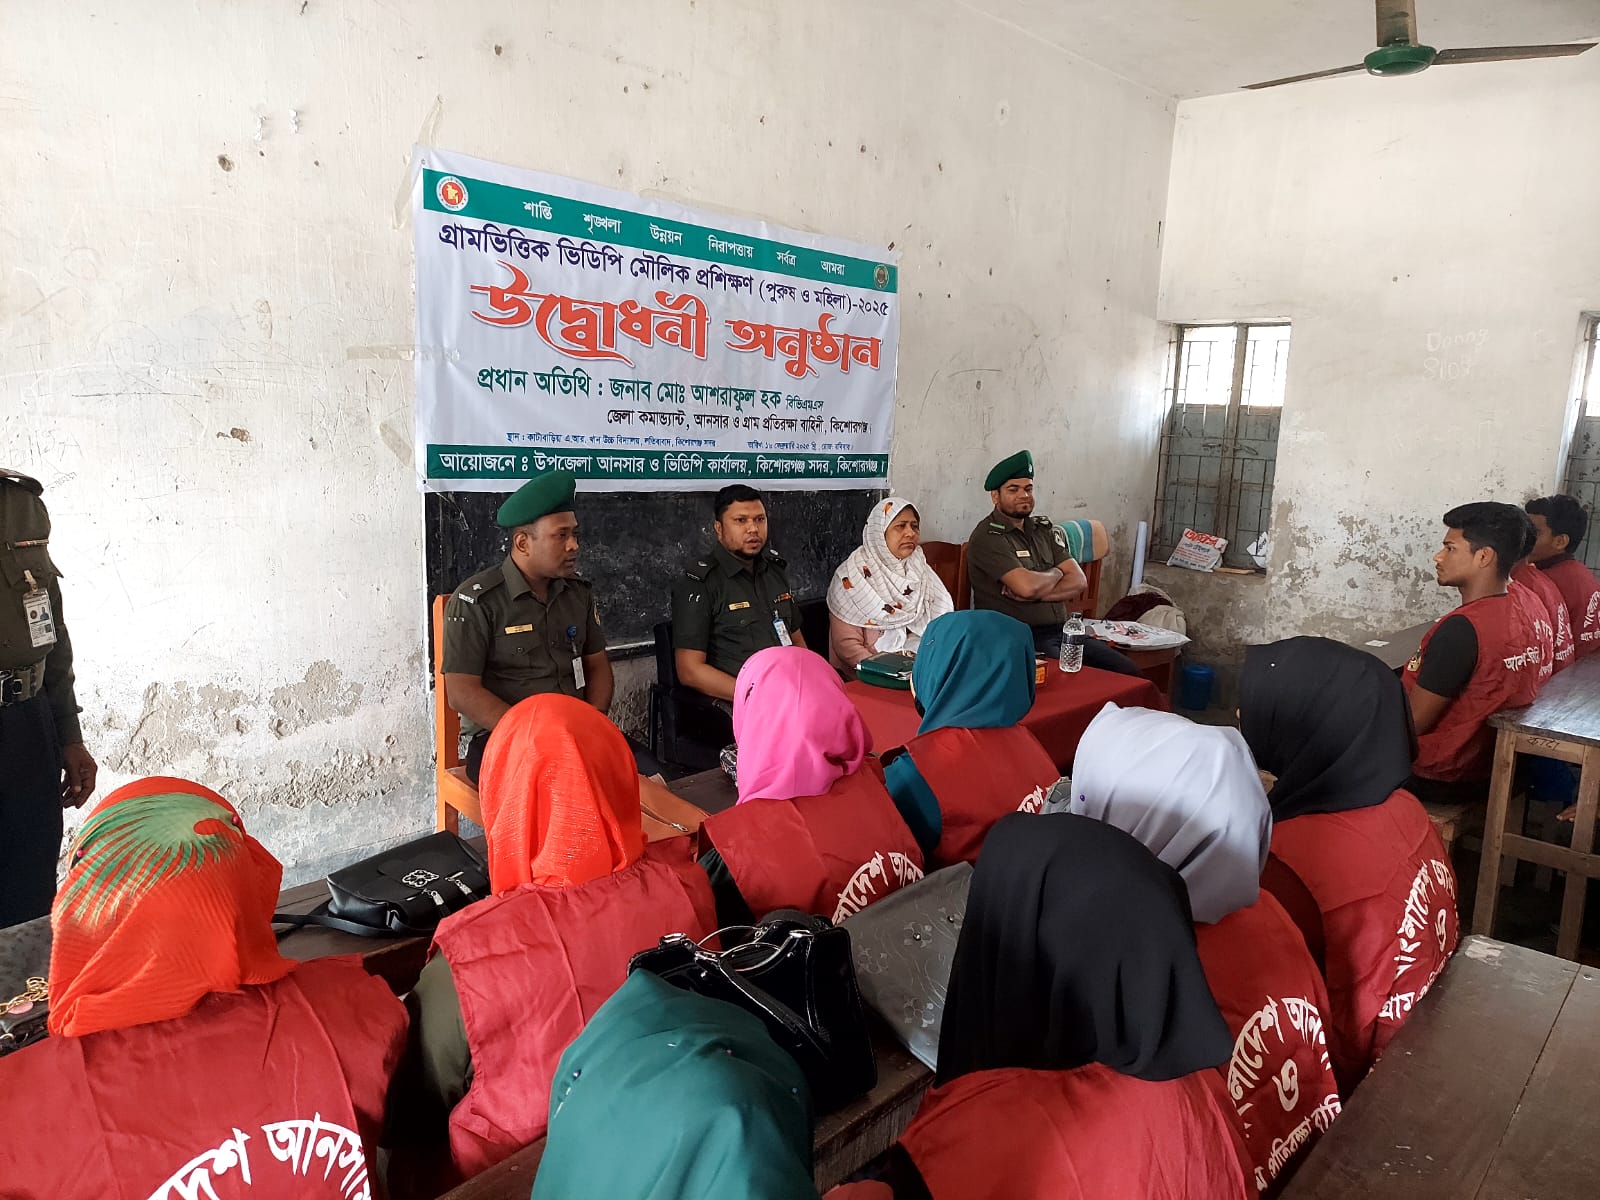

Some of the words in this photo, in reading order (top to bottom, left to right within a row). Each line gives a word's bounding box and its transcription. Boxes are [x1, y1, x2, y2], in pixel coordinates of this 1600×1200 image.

[438, 222, 551, 263] গ্রামভিত্তিক
[556, 237, 624, 275] ভিডিপি
[630, 250, 692, 285] মৌলিক
[696, 263, 754, 296] প্রশিক্ষণ
[759, 279, 797, 305] (পুরুষ
[801, 289, 810, 303] ও
[523, 200, 553, 220] শান্তি
[583, 213, 622, 235] শৃঙ্খলা
[650, 222, 682, 246] উন্নয়ন
[707, 235, 755, 259] নিরাপত্তায়
[776, 251, 797, 267] সর্বত্র
[820, 260, 846, 276] আমরা
[470, 259, 711, 368] উদ্বোধনী
[725, 312, 883, 379] অনুষ্ঠান
[477, 366, 529, 394] প্রধান
[533, 366, 592, 398] অতিথি
[609, 378, 652, 403] জনাব
[657, 381, 686, 404] মোঃ
[691, 384, 756, 413] আশরাফুল
[760, 390, 783, 410] হক
[607, 409, 635, 426] জেলা
[694, 414, 730, 429] আনসার
[733, 417, 740, 429] ও
[742, 416, 760, 432] গ্রাম
[762, 414, 798, 432] প্রতিরক্ষা
[439, 452, 516, 472] আয়োজনে
[533, 449, 593, 473] উপজেলা
[597, 455, 645, 473] আনসার
[649, 457, 660, 473] ও
[664, 453, 704, 473] ভিডিপি
[756, 454, 805, 475] কিশোরগঞ্জ
